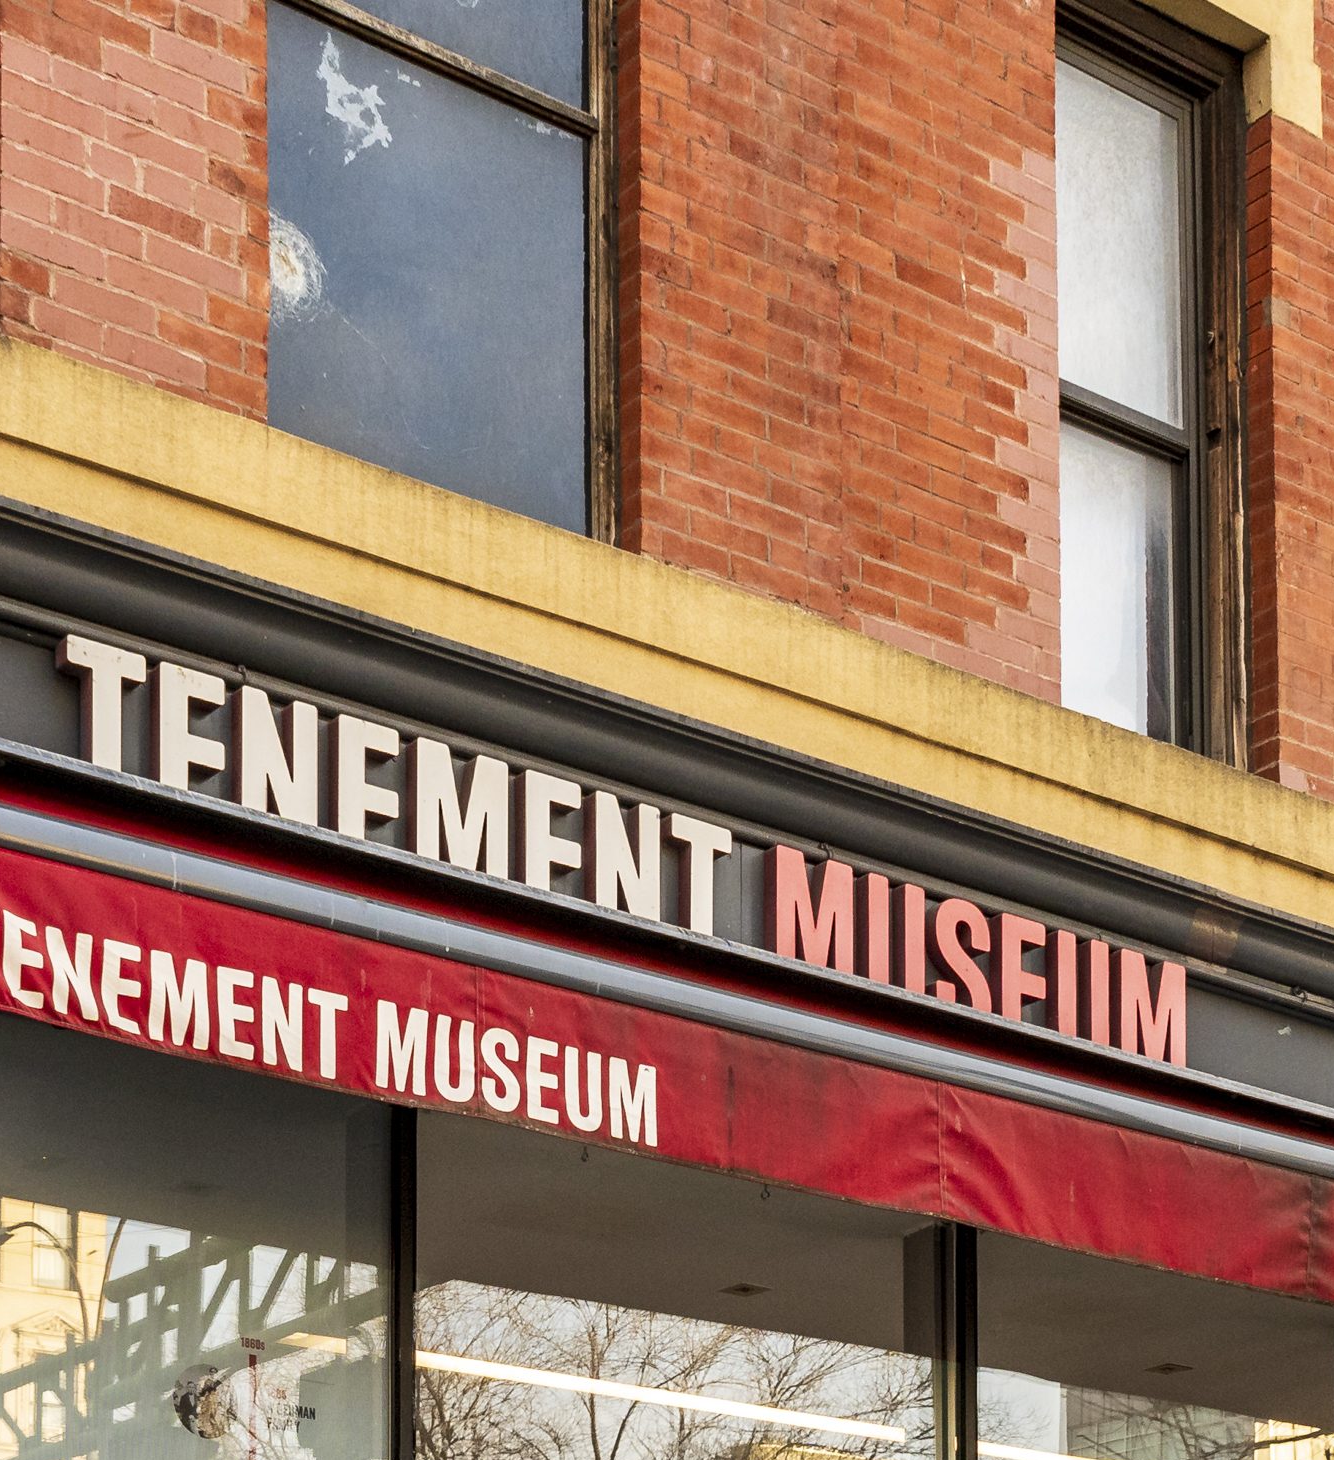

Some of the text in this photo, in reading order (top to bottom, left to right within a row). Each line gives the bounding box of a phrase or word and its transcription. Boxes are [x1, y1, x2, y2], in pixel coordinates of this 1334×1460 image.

[58, 632, 1190, 1069] TENEMENT MUSEUM
[373, 1004, 659, 1148] MUSEUM
[240, 1336, 266, 1351] 1860s
